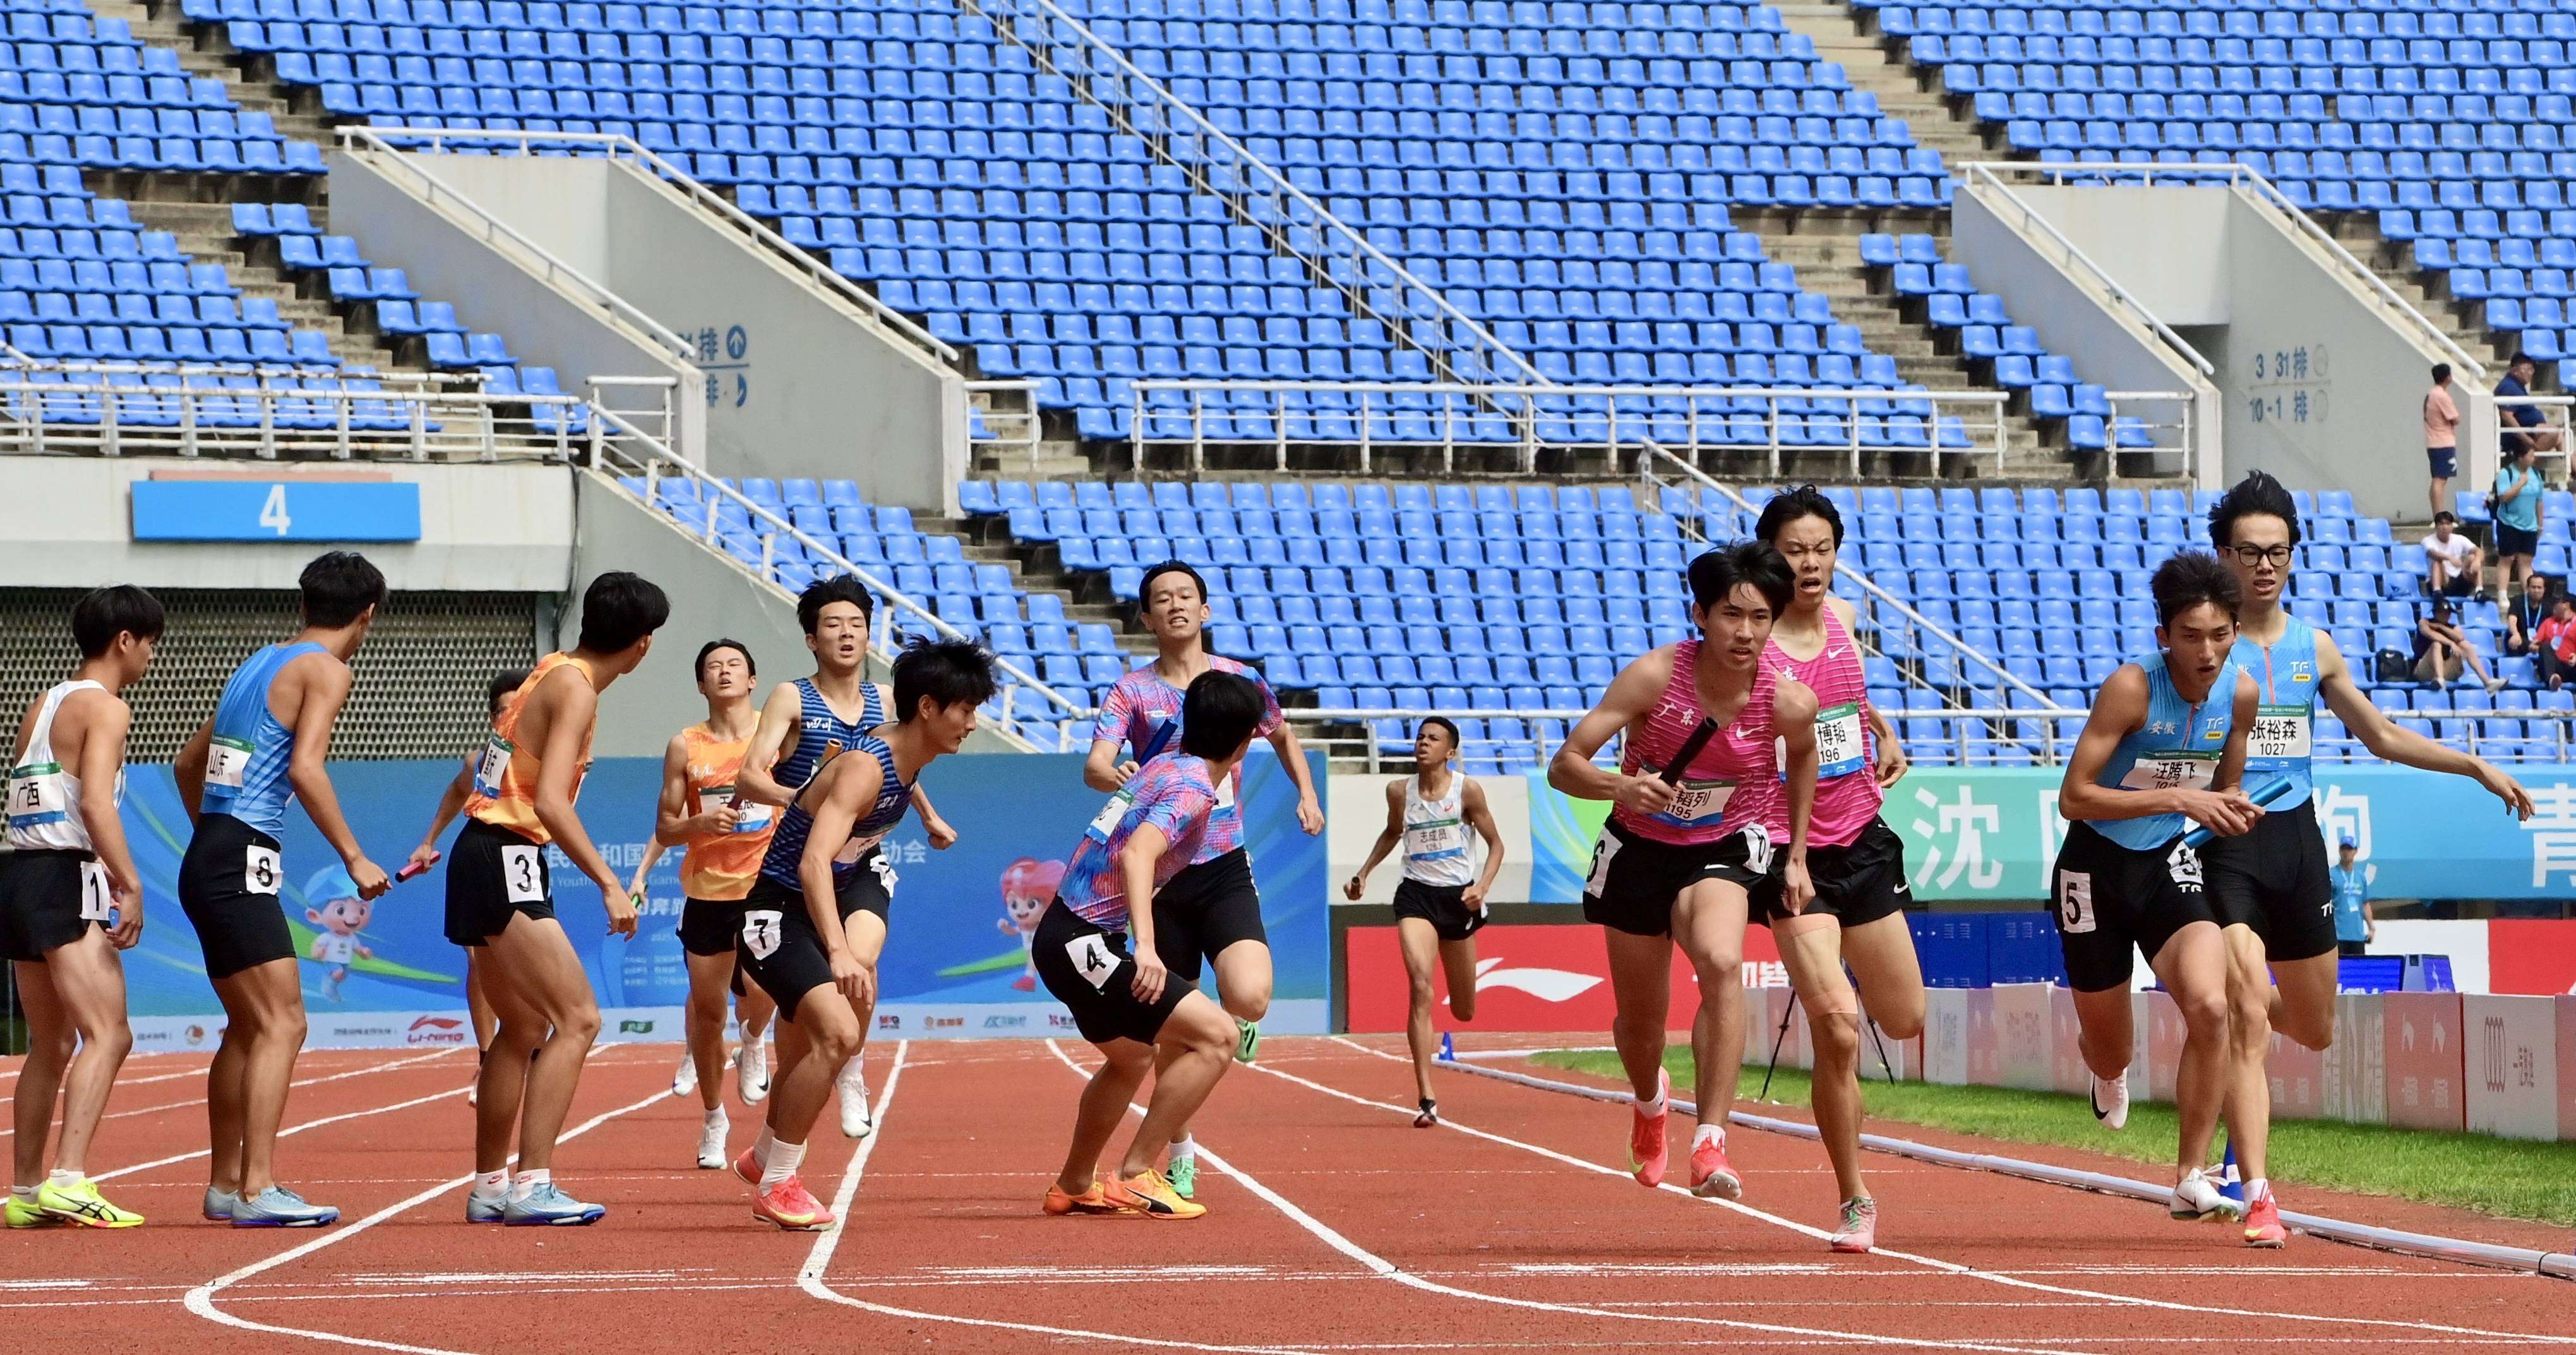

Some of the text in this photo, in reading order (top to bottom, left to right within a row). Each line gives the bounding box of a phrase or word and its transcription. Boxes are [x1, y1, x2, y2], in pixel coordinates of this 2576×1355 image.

[259, 484, 291, 536] 4
[2290, 662, 2309, 672] TF
[1658, 701, 1695, 725] 广东
[2206, 717, 2224, 729] TF
[2148, 720, 2176, 735] 安徽
[2251, 719, 2297, 741] 张裕森
[2260, 743, 2286, 756] 1027
[2152, 761, 2197, 780] 汪腾飞
[16, 782, 40, 808] 广西
[1670, 789, 1711, 808] 韬列
[1666, 804, 1692, 819] 1195
[256, 856, 273, 888] 8
[1586, 839, 1606, 883] 6
[515, 854, 532, 893] 3
[90, 872, 99, 911] 1
[2066, 881, 2081, 925] 5
[753, 919, 769, 950] 7
[1086, 943, 1106, 972] 4
[408, 1033, 464, 1043] LI-NING
